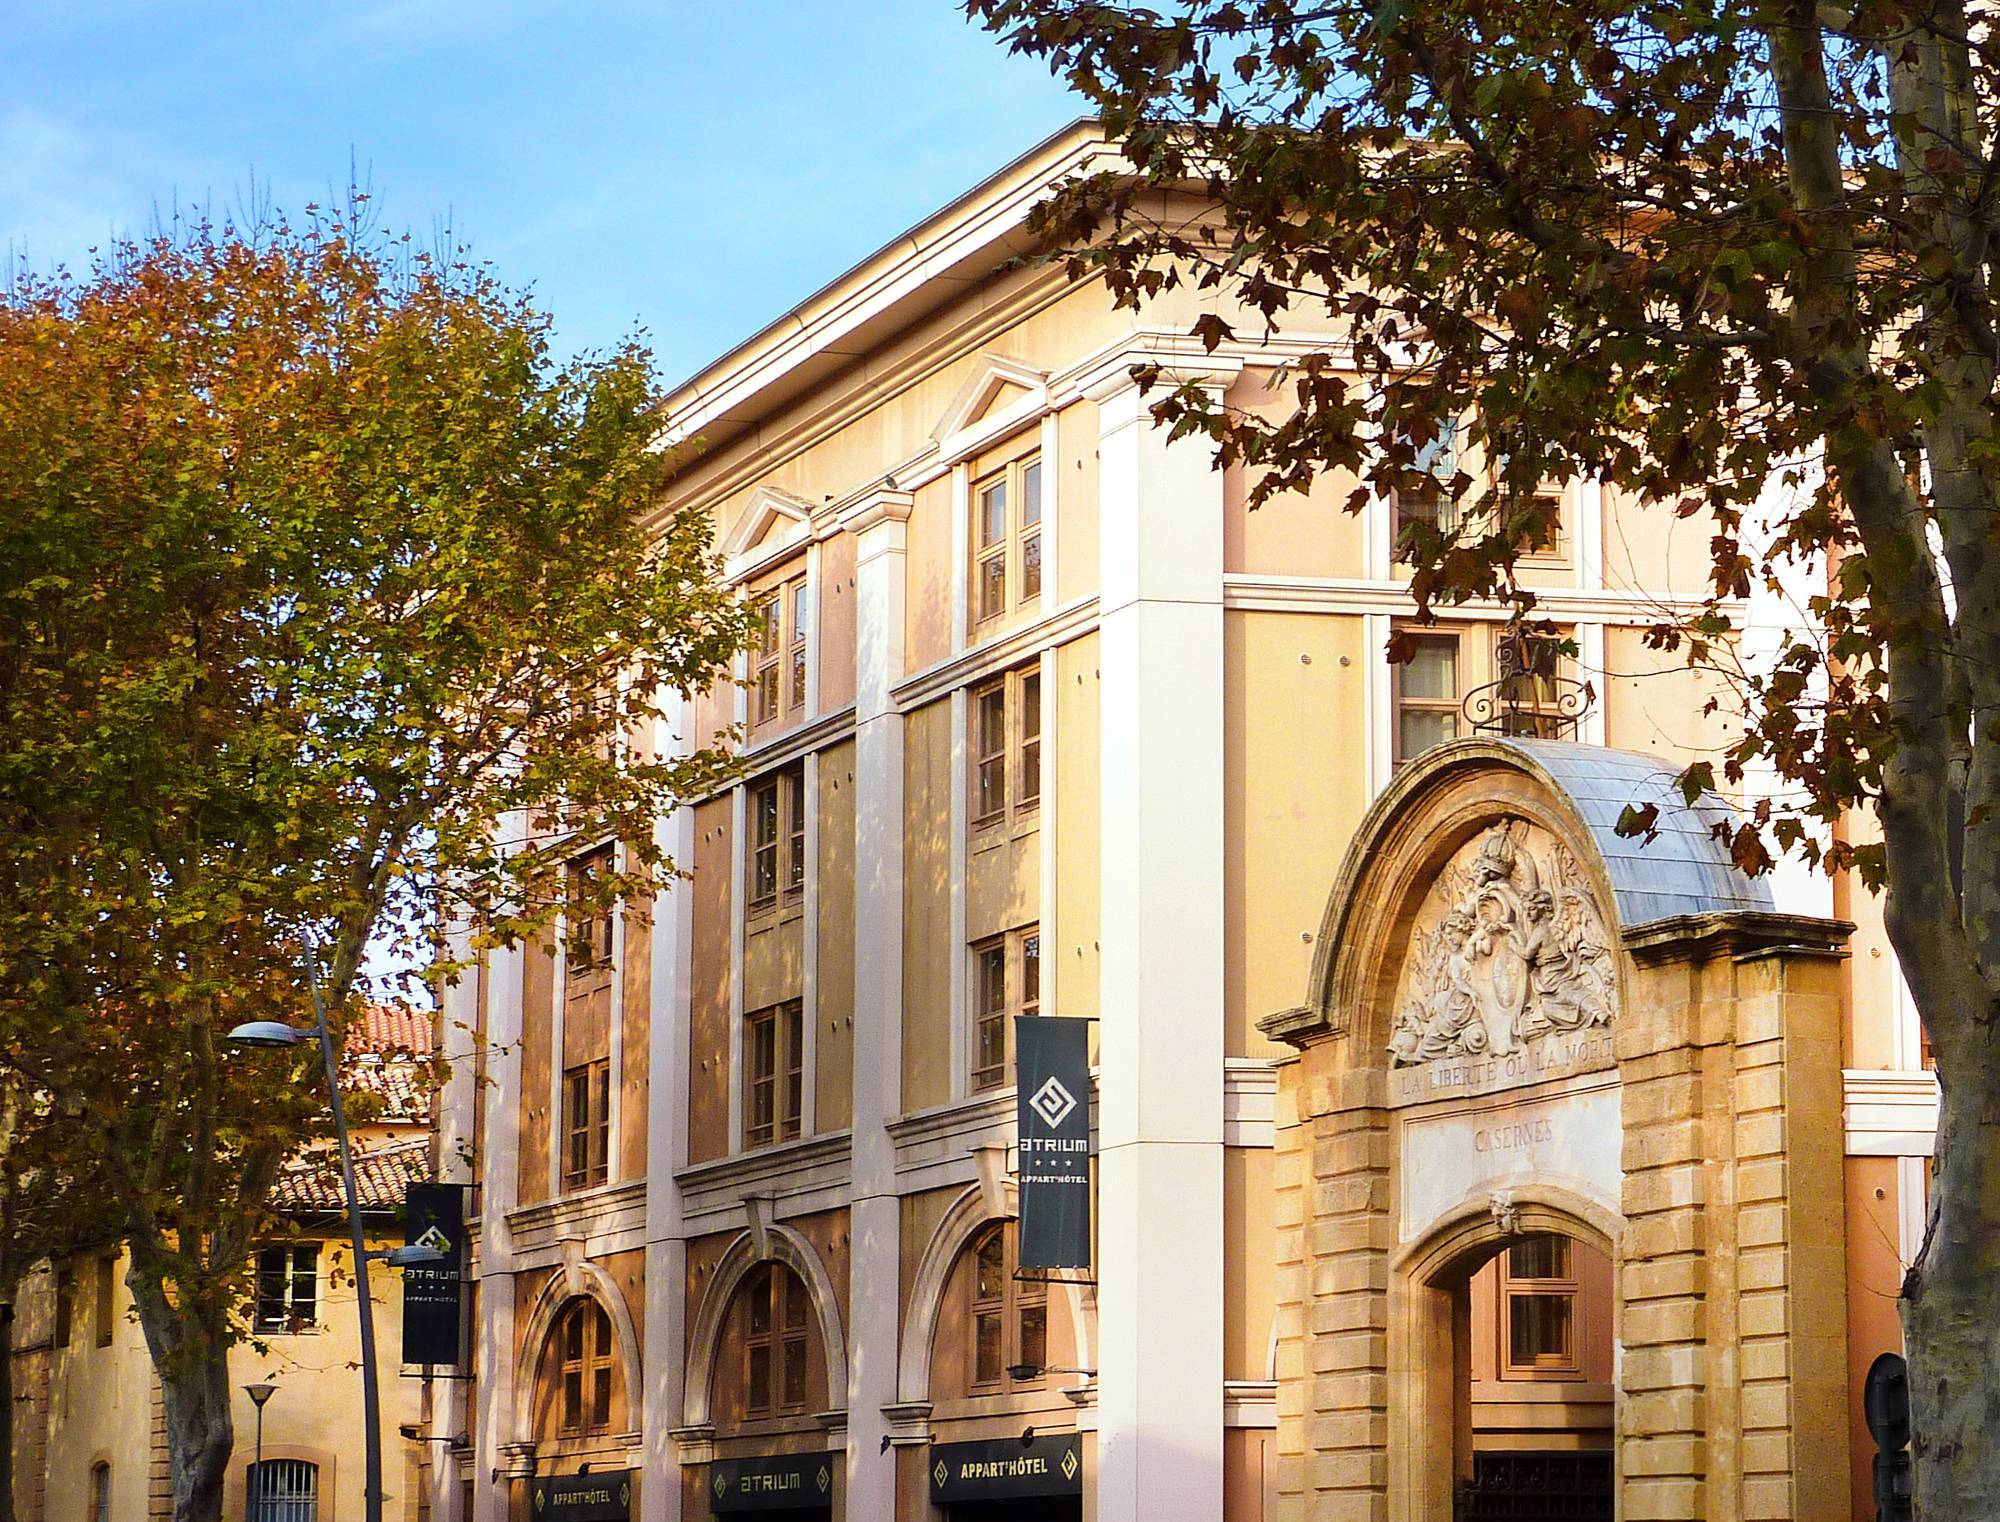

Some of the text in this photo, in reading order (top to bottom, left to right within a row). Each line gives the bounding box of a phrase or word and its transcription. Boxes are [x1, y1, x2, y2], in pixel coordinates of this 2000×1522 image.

[1401, 1074, 1422, 1095] LA
[1506, 1056, 1527, 1077] OU
[1536, 1050, 1561, 1071] LA
[1474, 1119, 1554, 1153] CASERNES
[960, 1456, 1048, 1480] APPART'HÔTEL
[552, 1488, 610, 1505] APPART'HÔTEL
